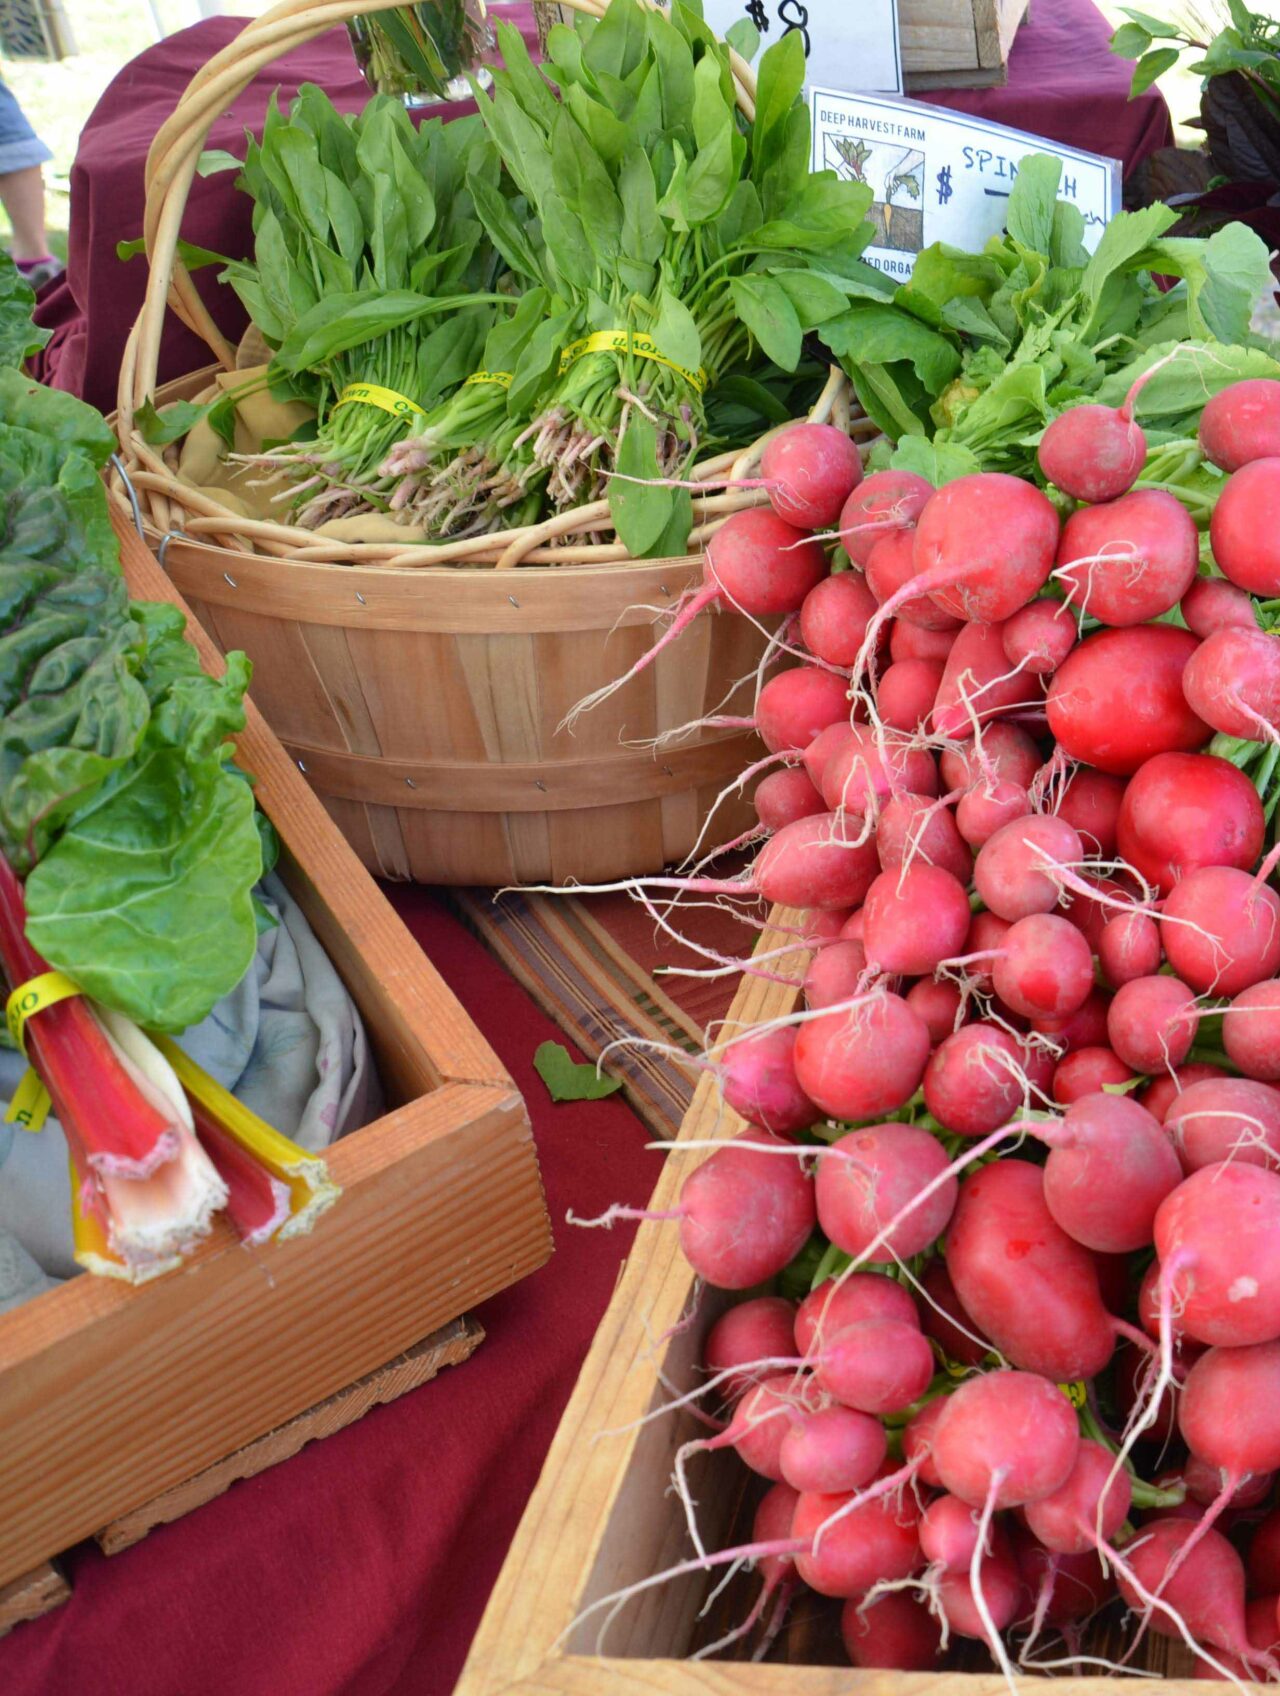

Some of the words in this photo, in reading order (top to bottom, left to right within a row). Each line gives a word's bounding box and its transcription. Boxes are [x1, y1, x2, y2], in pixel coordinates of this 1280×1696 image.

[820, 110, 846, 125] DEEP
[847, 115, 895, 134] HARVEST
[897, 125, 926, 141] FARM
[936, 165, 953, 205] $
[883, 260, 914, 275] ORGA
